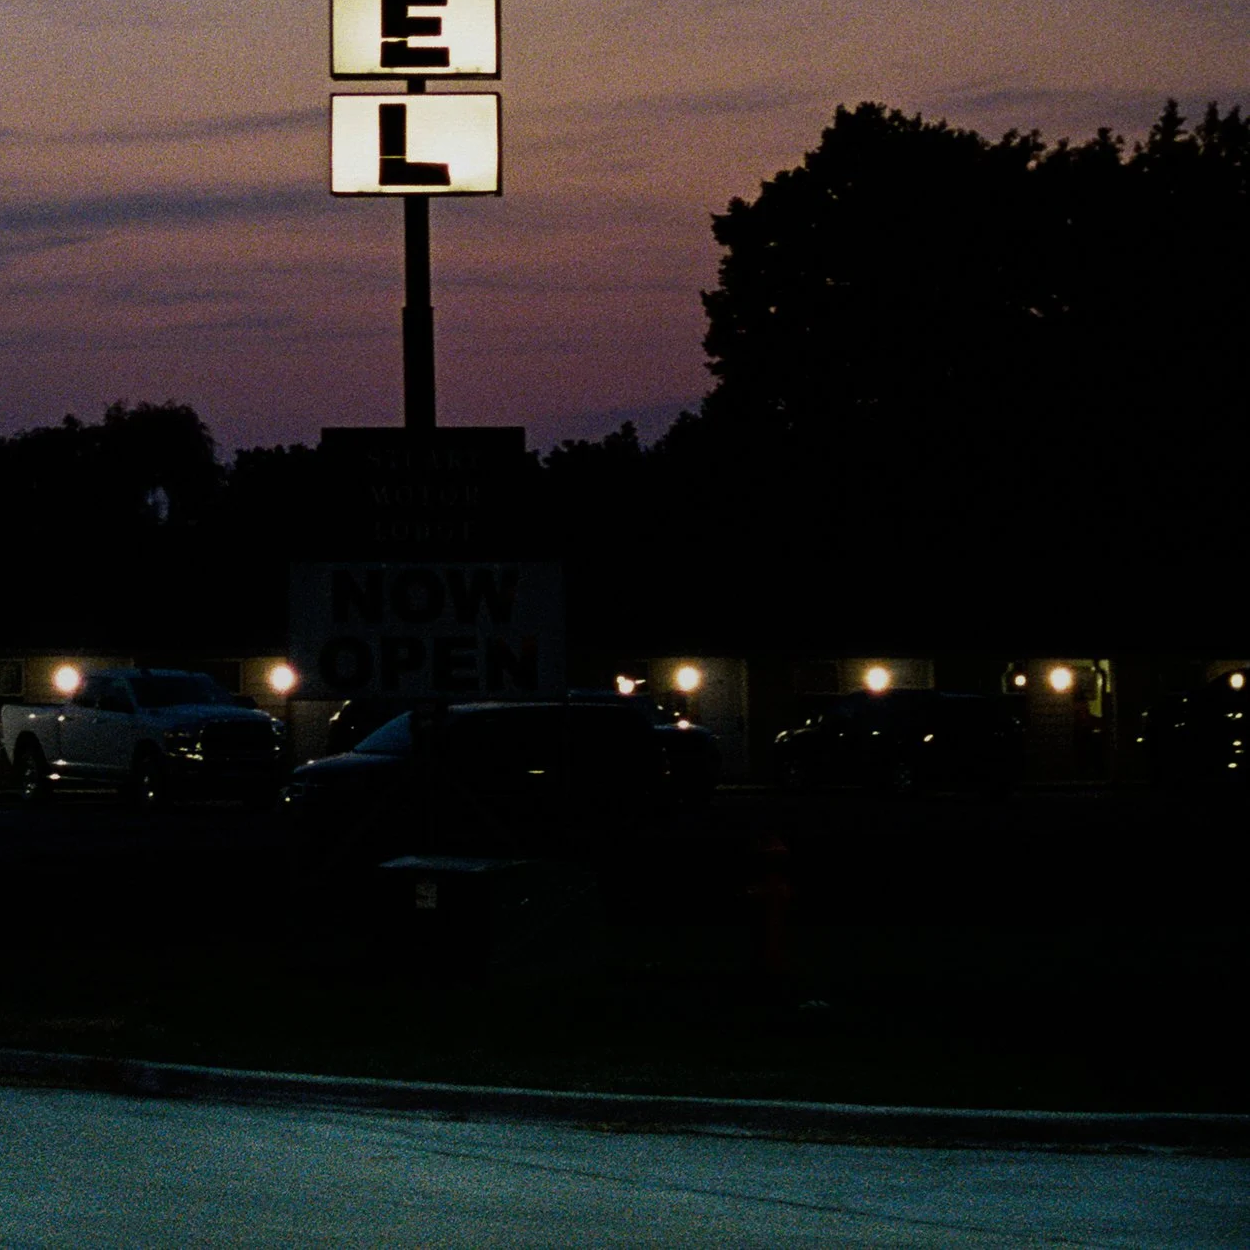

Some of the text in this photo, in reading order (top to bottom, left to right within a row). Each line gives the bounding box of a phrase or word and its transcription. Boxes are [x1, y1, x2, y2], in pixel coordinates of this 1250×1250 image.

[370, 485, 480, 506] MOTOR
[331, 570, 519, 624] NOW
[319, 636, 538, 690] OPEN
